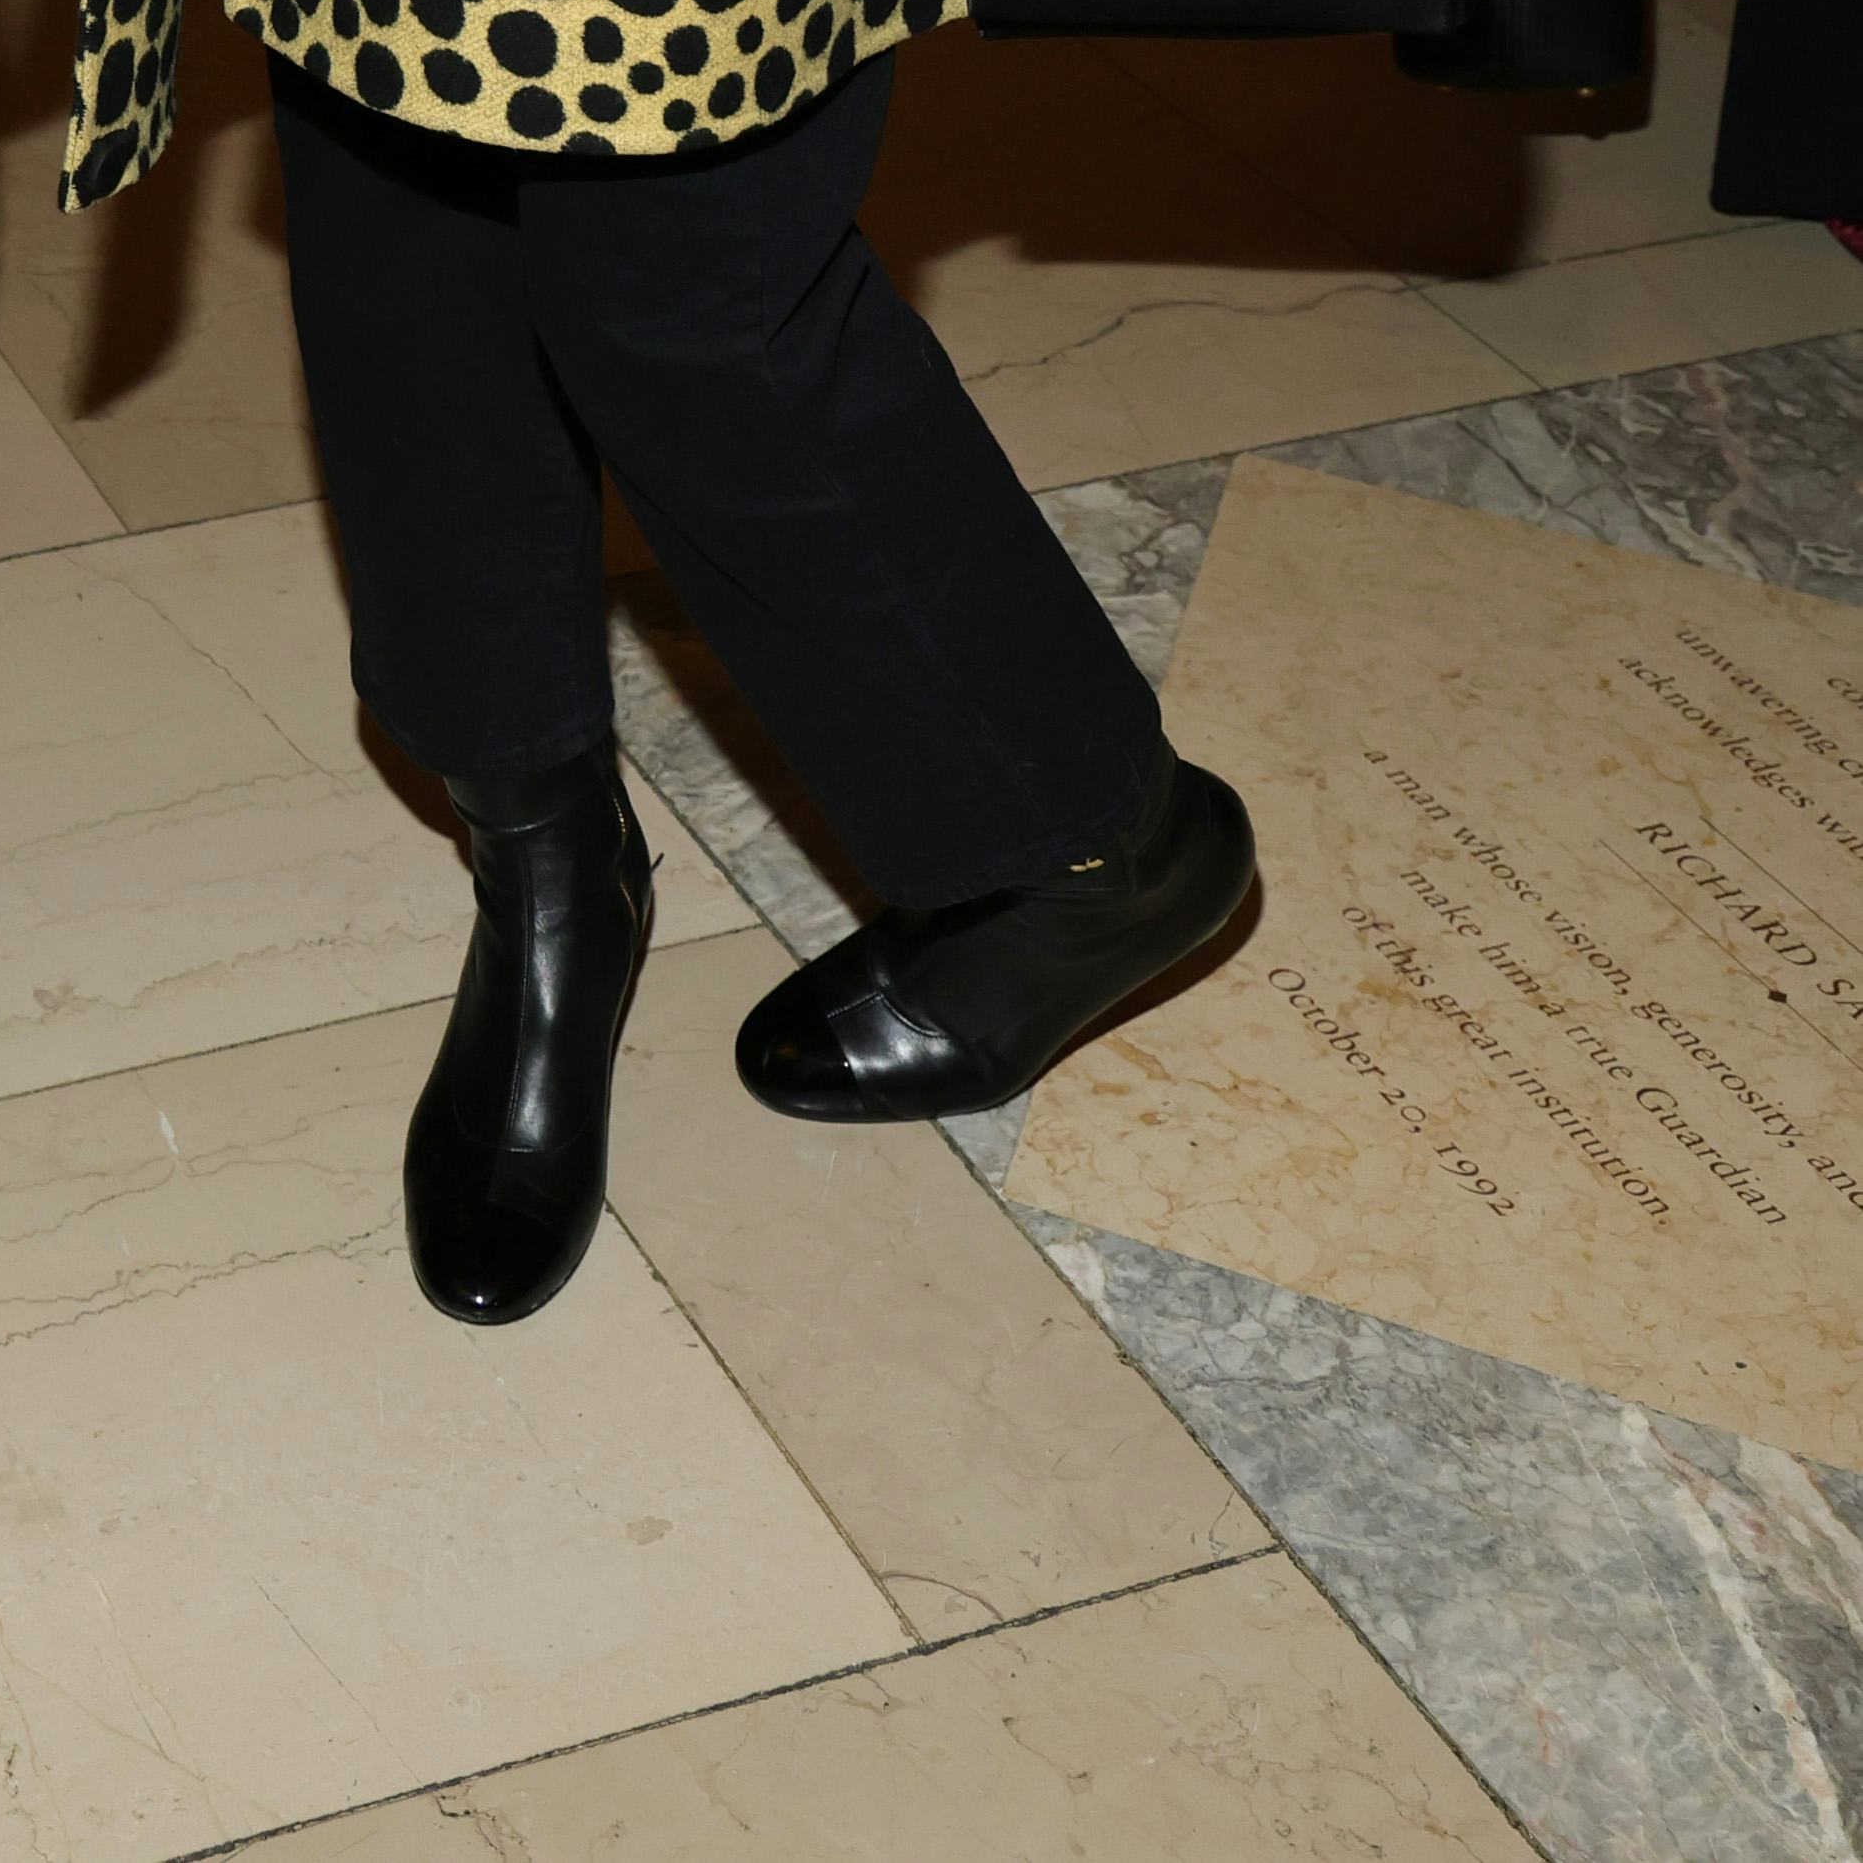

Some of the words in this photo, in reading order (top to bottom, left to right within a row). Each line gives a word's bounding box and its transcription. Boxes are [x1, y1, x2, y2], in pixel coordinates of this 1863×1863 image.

[1618, 657, 1815, 809] acknowledges
[1675, 630, 1839, 755] unwavering
[1363, 749, 1389, 765] a
[1385, 769, 1451, 823] man
[1453, 826, 1542, 904] whose
[1543, 909, 1634, 996] vision,
[1630, 1000, 1804, 1149] generosity,
[1634, 821, 1818, 967] RICHARD
[1267, 967, 1386, 1078] October
[1378, 1087, 1427, 1134] 20,
[1433, 1141, 1516, 1217] 1992
[1342, 906, 1395, 934] of
[1375, 938, 1436, 988] this
[1421, 993, 1514, 1062] great
[1508, 1067, 1671, 1225] institution.
[1399, 869, 1483, 938] make
[1477, 941, 1542, 996] him
[1538, 1001, 1566, 1019] a
[1565, 1024, 1634, 1081] true
[1635, 1086, 1788, 1225] Guardian
